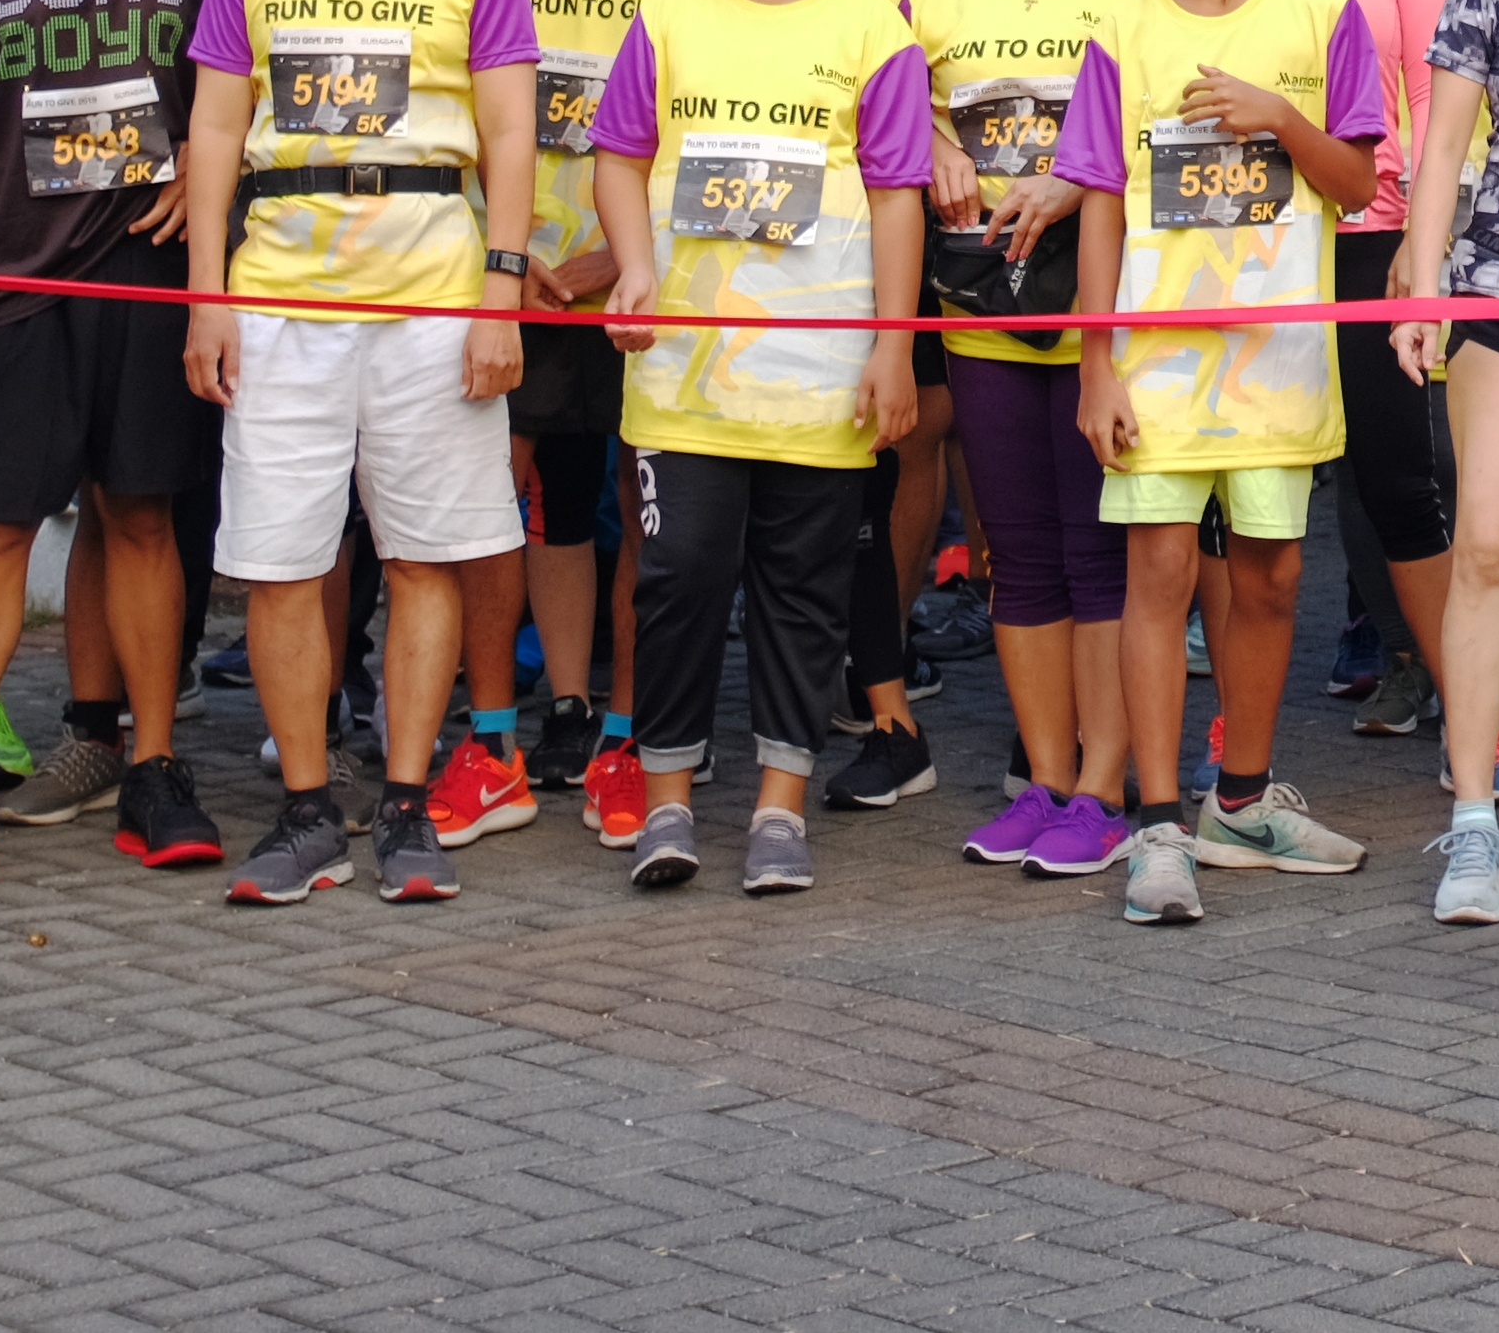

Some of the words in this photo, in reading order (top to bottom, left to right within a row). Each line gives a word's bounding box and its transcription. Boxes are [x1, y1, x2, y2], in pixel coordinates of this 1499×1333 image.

[372, 0, 435, 26] GIVE
[994, 39, 1028, 59] TO
[1036, 38, 1087, 59] GIV
[292, 73, 378, 106] 5194
[356, 114, 387, 134] 5K
[671, 97, 717, 120] RUN
[726, 100, 760, 122] TO
[770, 103, 831, 129] GIVE
[981, 116, 1057, 147] 5379
[123, 161, 153, 184] 5K
[1180, 161, 1268, 198] 5395
[702, 177, 793, 213] 5377
[1250, 201, 1277, 223] 5K
[766, 221, 798, 241] 5K
